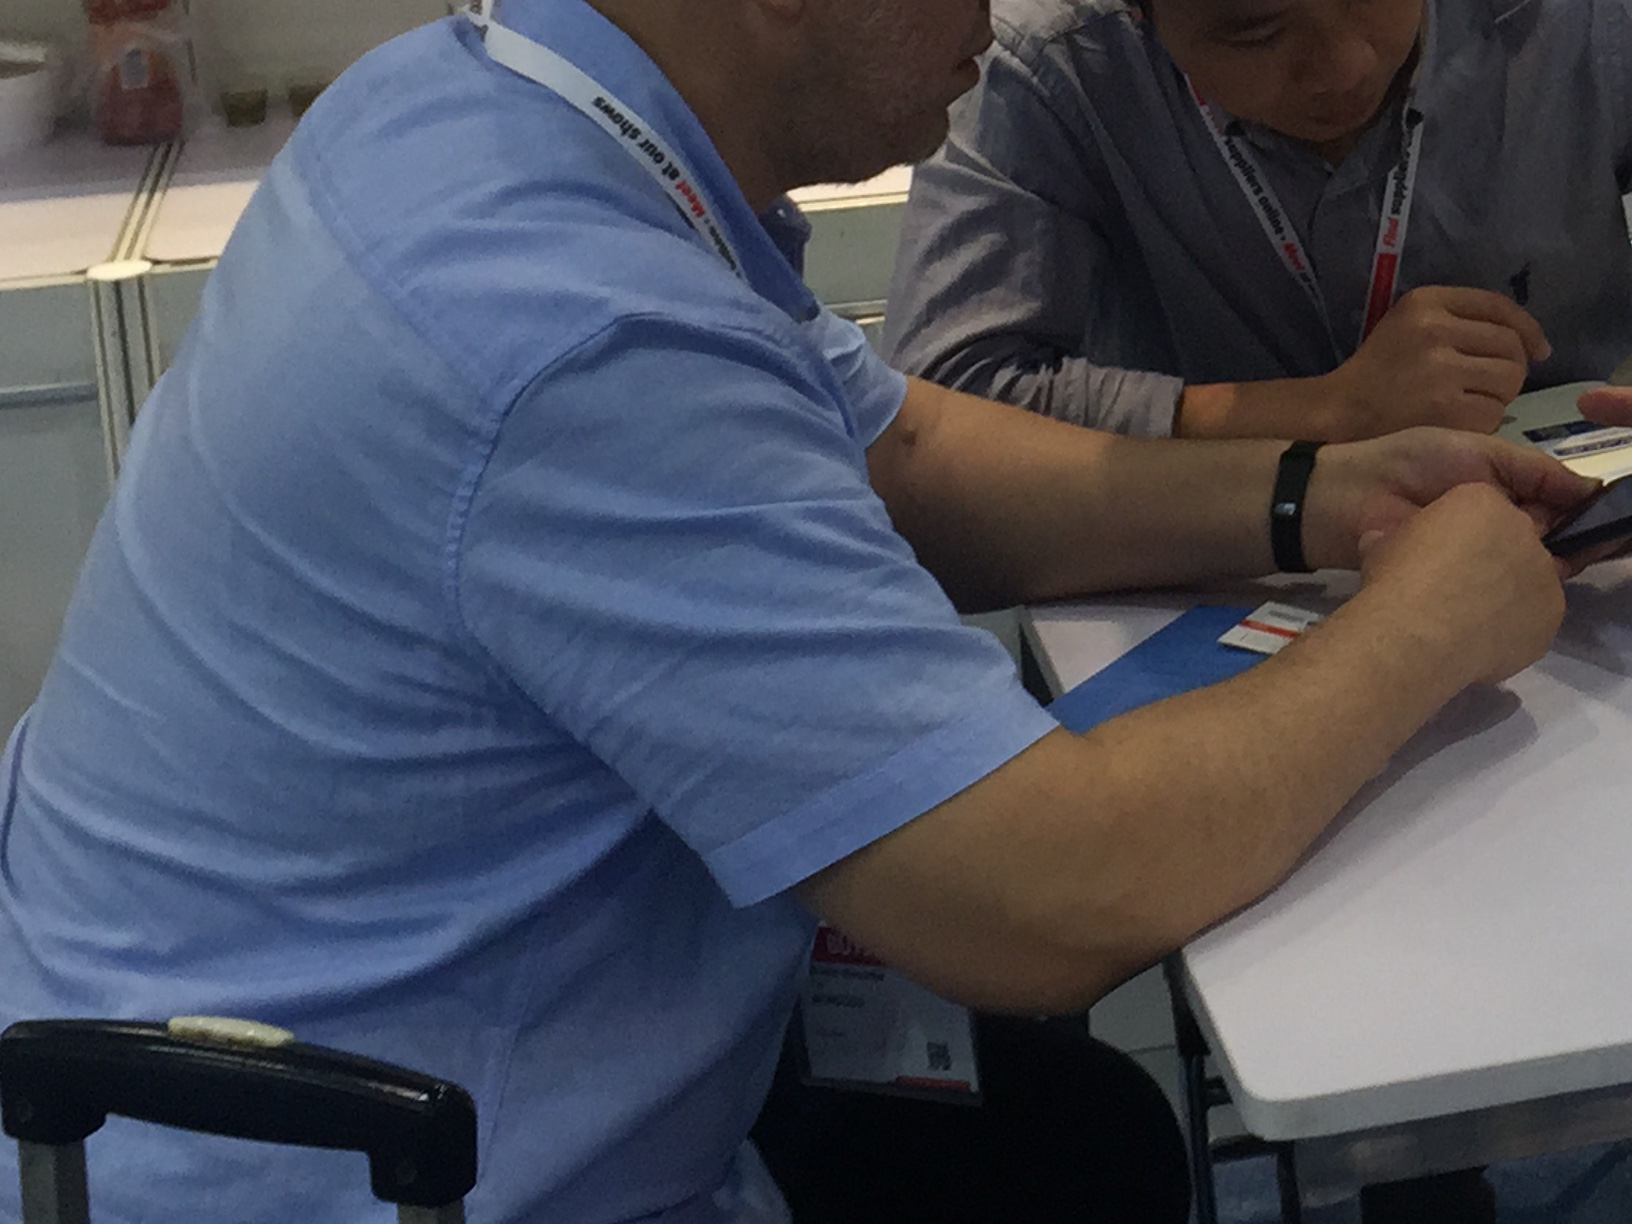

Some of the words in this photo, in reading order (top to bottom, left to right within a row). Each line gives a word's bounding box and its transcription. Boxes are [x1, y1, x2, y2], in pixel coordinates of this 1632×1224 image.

[592, 97, 640, 139] shows
[637, 138, 667, 166] our
[662, 161, 680, 181] at
[675, 179, 706, 218] Meet
